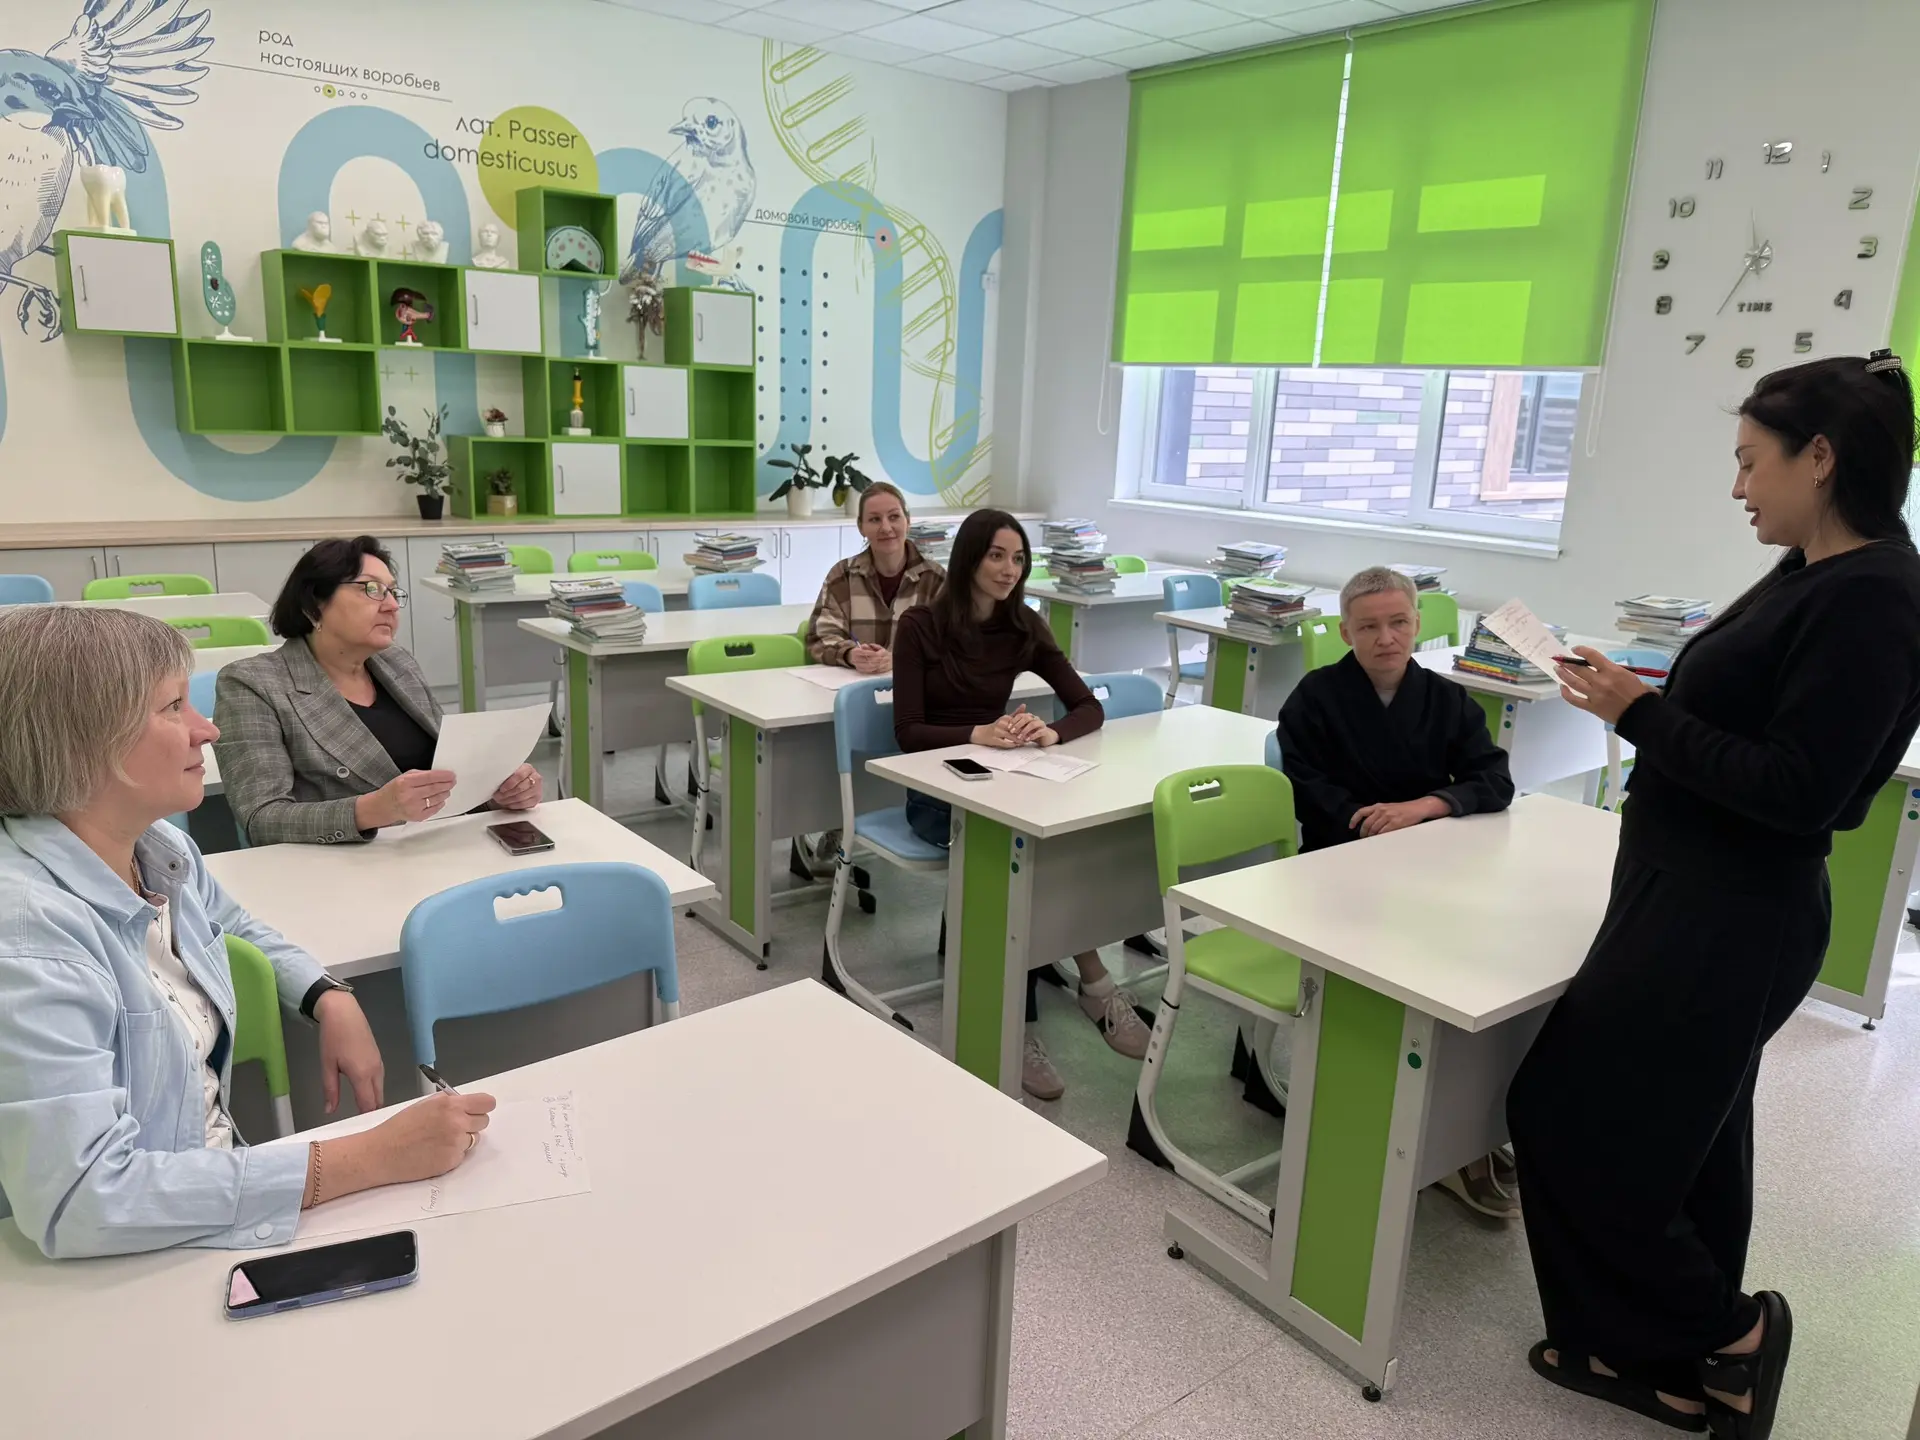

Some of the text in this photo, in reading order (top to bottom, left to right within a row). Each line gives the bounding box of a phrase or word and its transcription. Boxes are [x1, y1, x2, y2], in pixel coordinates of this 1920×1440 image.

[258, 27, 294, 48] род
[259, 50, 440, 93] настоящих воробьев
[456, 116, 578, 150] лат. Passer
[423, 139, 578, 180] domesticusus
[1763, 141, 1793, 165] 12
[1821, 151, 1831, 173] 1
[1706, 158, 1724, 180] 11
[1669, 197, 1696, 218] 10
[1848, 187, 1873, 210] 2
[755, 208, 862, 233] домовой воробей
[1857, 236, 1879, 259] 3
[1652, 250, 1670, 271] 9
[1655, 296, 1673, 315] 8
[1737, 302, 1773, 313] TIME
[1834, 289, 1853, 310] 4
[1685, 334, 1706, 355] 7
[1794, 332, 1813, 353] 5
[1736, 348, 1754, 368] 6
